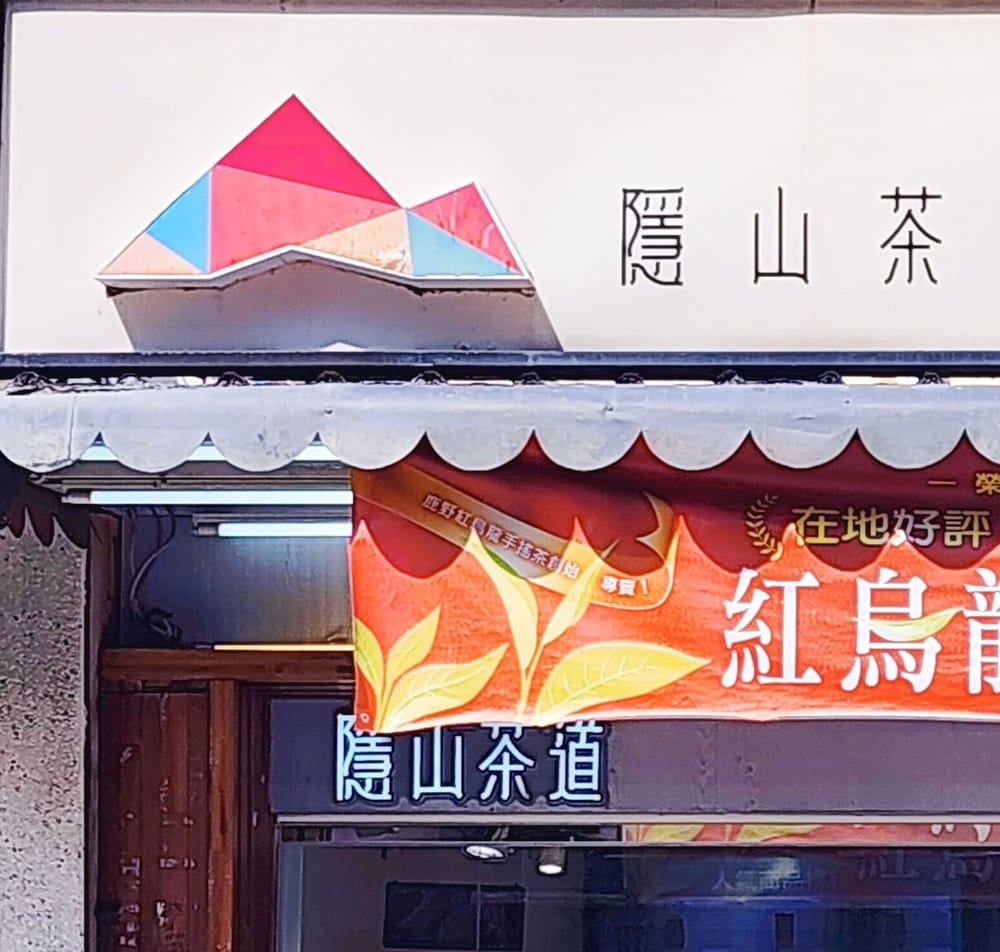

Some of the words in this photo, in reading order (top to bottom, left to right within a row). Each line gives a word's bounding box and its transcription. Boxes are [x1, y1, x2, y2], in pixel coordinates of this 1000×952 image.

[793, 507, 992, 548] 在地好評
[335, 713, 605, 802] 隱山茶道
